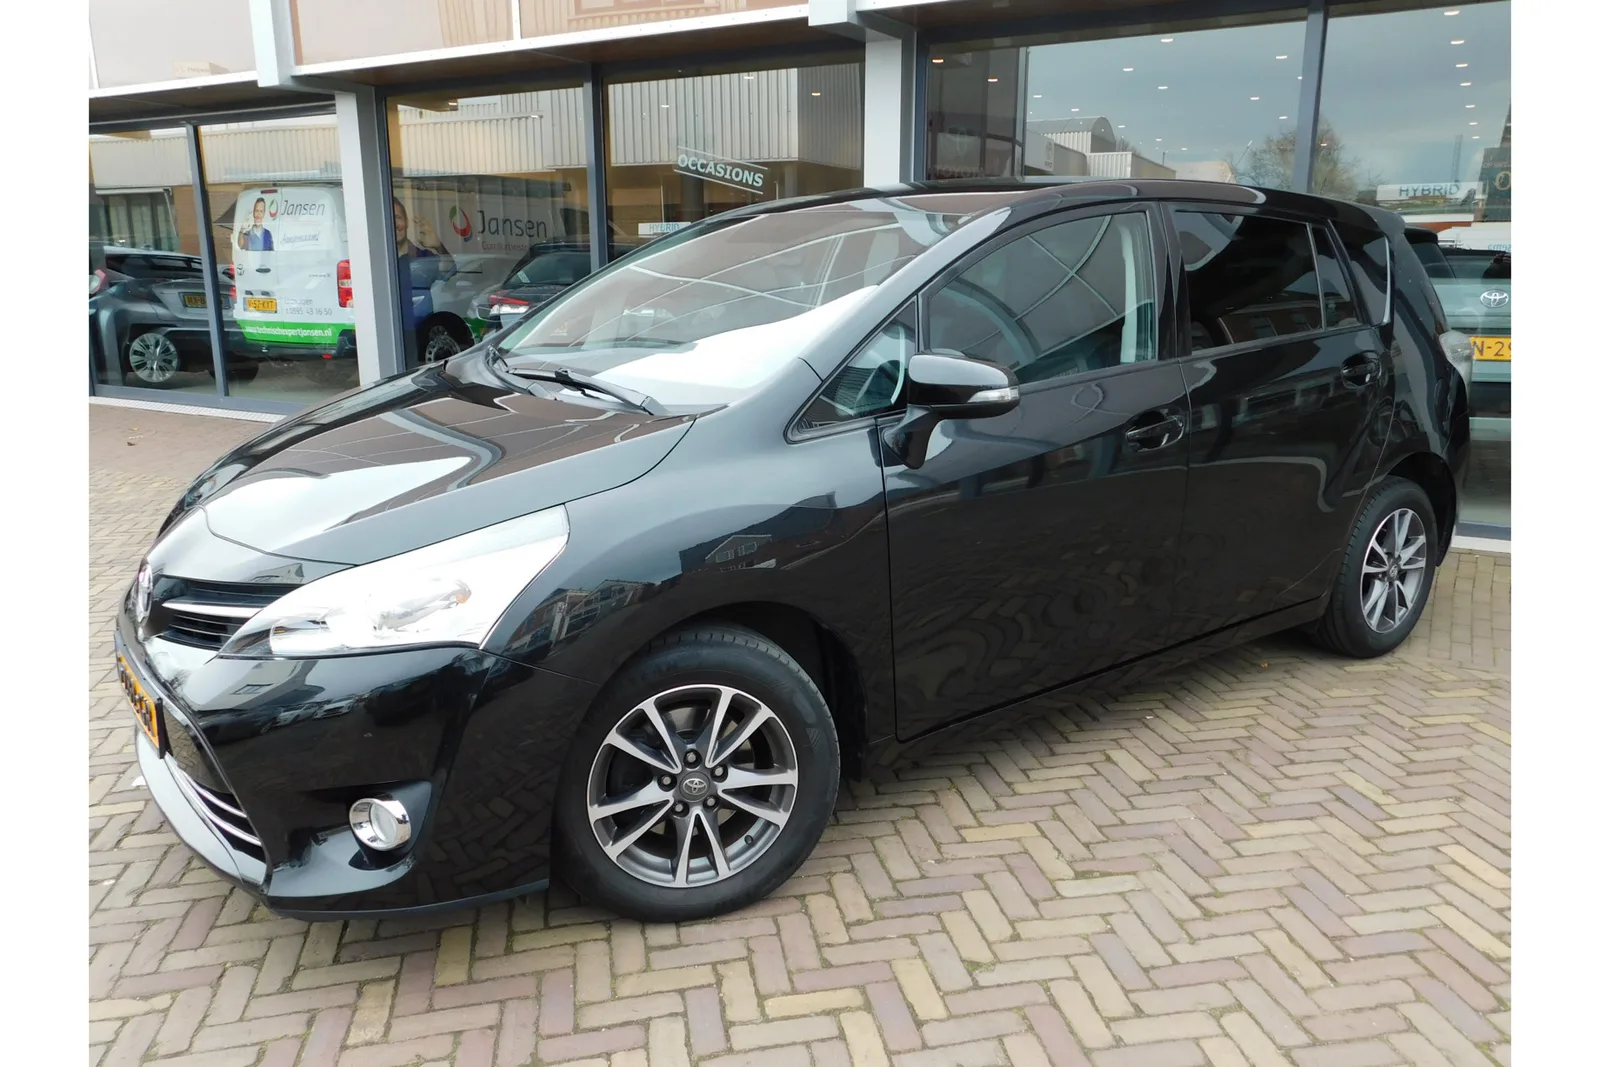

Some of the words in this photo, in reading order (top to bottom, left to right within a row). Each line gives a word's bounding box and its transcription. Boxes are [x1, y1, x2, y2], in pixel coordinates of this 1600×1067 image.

[677, 154, 764, 187] OCCASIONS
[1398, 183, 1460, 198] HYBRID
[281, 200, 326, 216] Jansen
[477, 210, 548, 239] Jansen
[649, 222, 680, 233] HYBRID
[323, 308, 333, 316] 50
